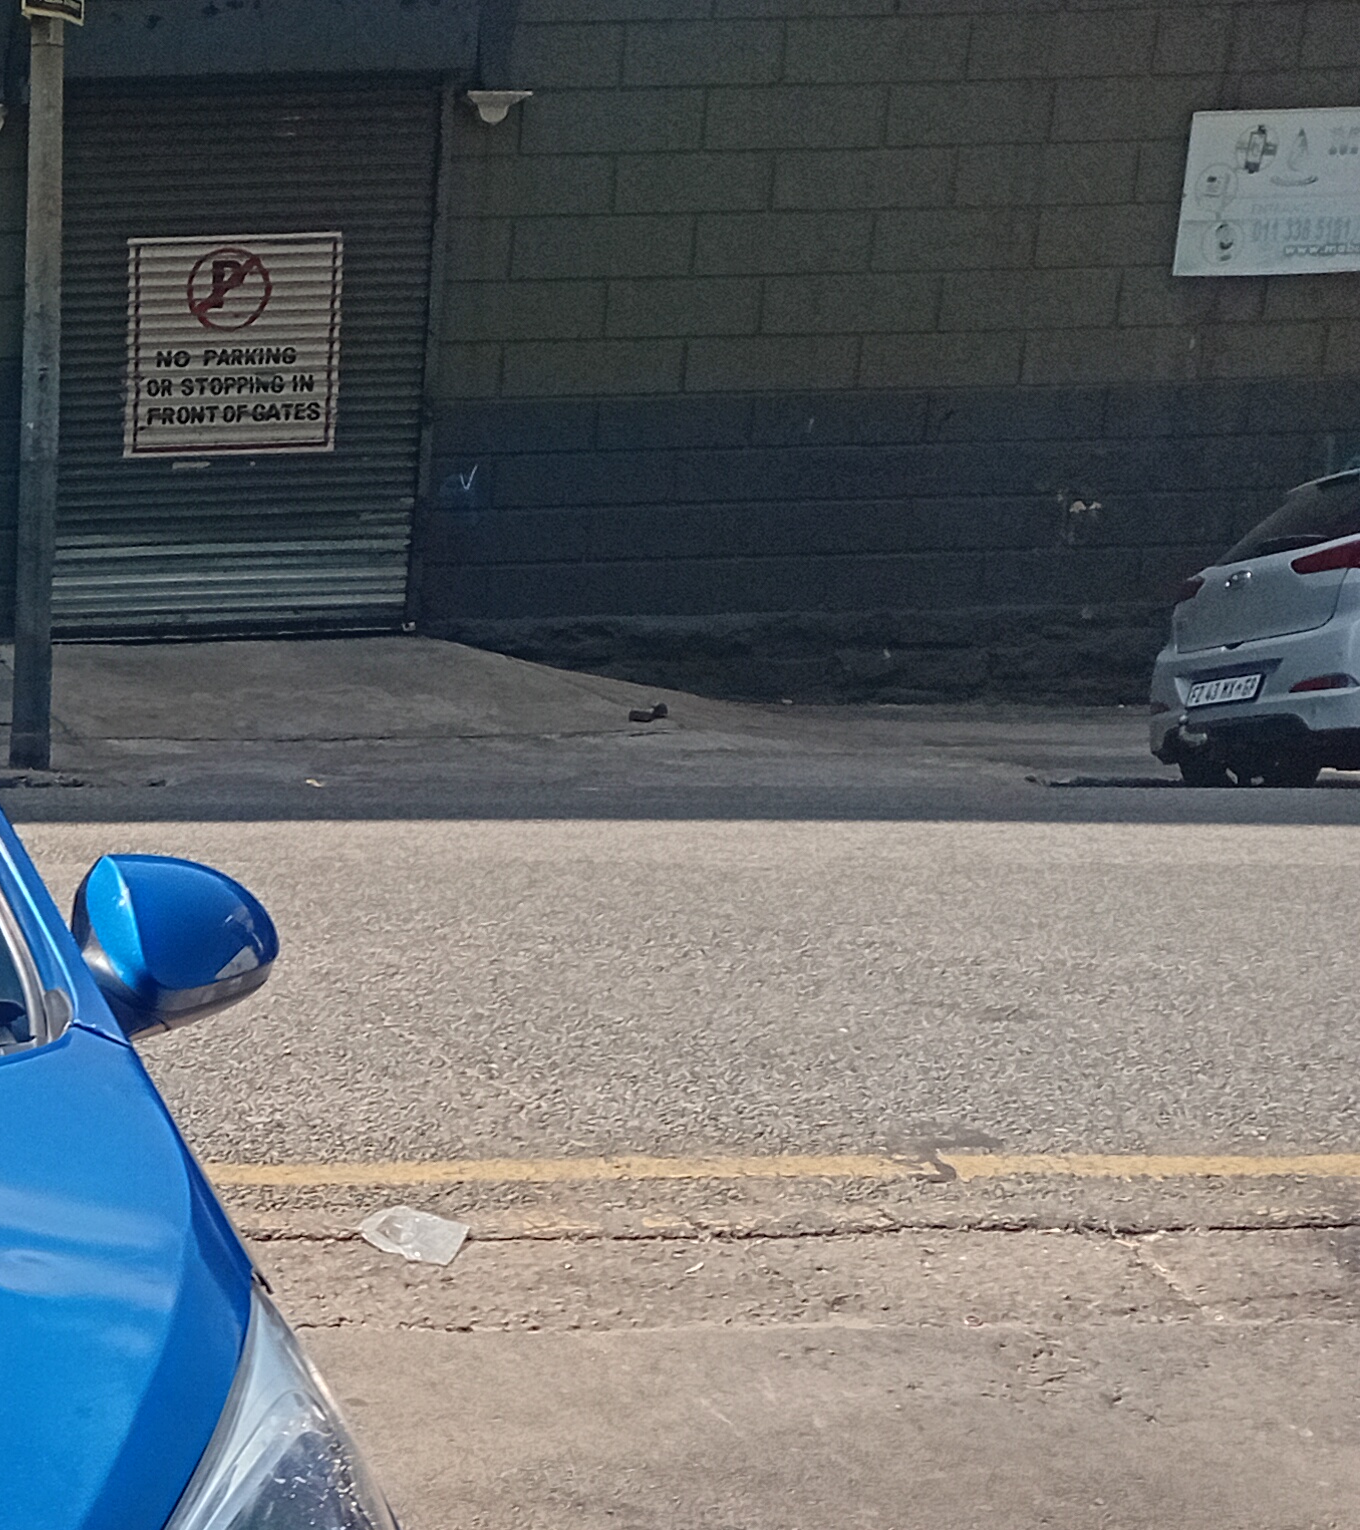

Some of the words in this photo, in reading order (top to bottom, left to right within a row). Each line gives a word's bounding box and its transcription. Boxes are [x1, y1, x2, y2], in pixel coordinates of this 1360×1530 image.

[155, 349, 191, 368] NO
[203, 346, 298, 367] PARKING
[146, 378, 173, 397] OR
[180, 374, 285, 396] STOPPING
[292, 373, 315, 393] IN
[146, 404, 219, 425] FRONT
[222, 403, 248, 424] OF
[251, 401, 321, 422] GATES
